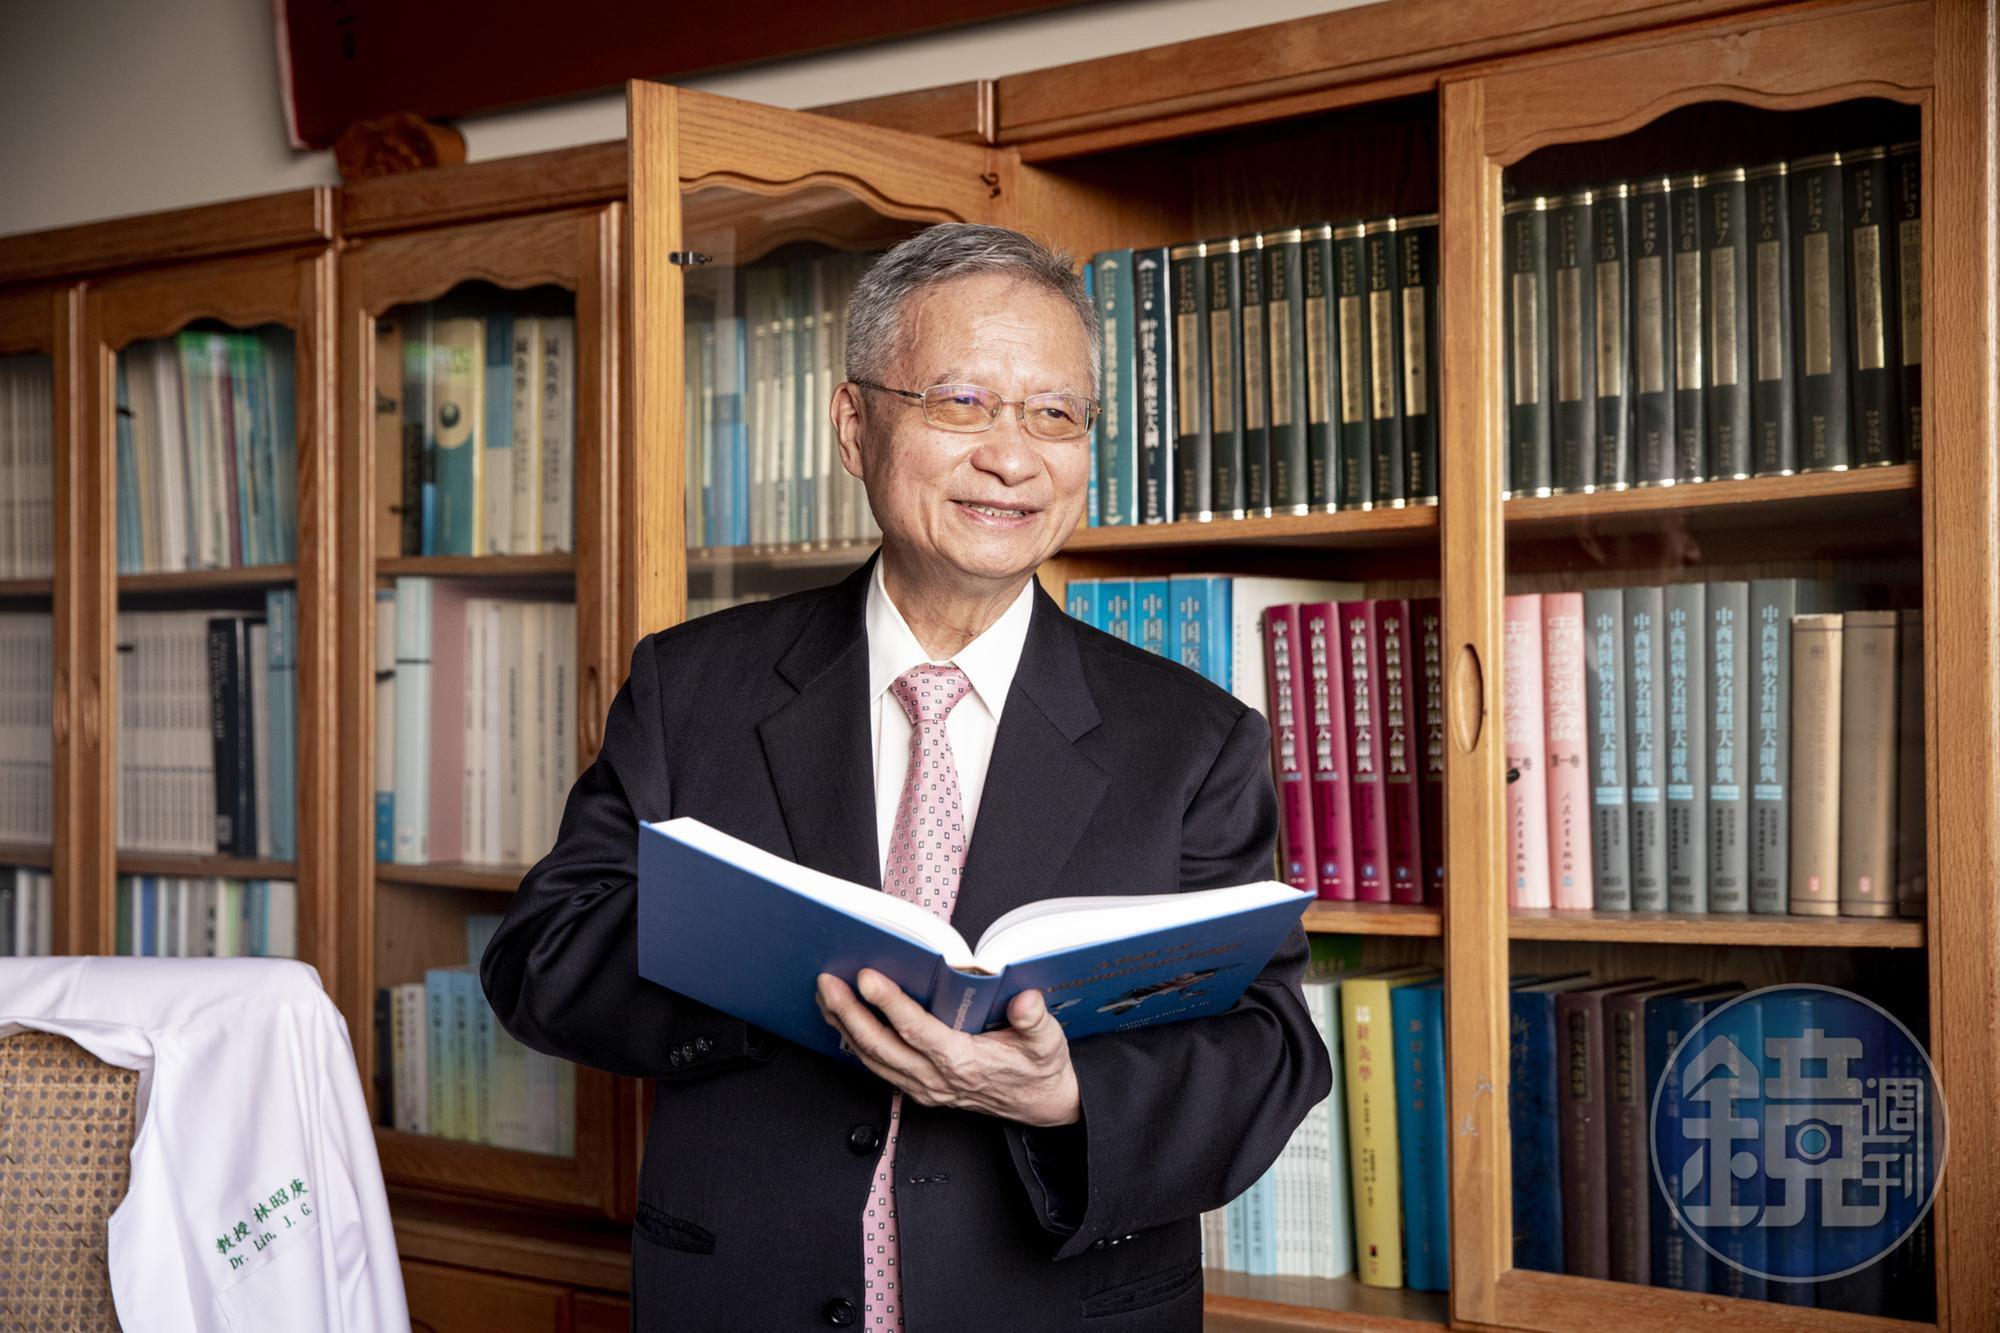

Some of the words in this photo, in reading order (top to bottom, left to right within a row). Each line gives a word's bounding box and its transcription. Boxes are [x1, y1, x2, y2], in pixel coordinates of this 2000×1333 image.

[216, 1221, 252, 1255] 教授
[229, 1254, 249, 1270] Dr.
[253, 1231, 277, 1252] Lin,
[283, 1215, 296, 1228] J.
